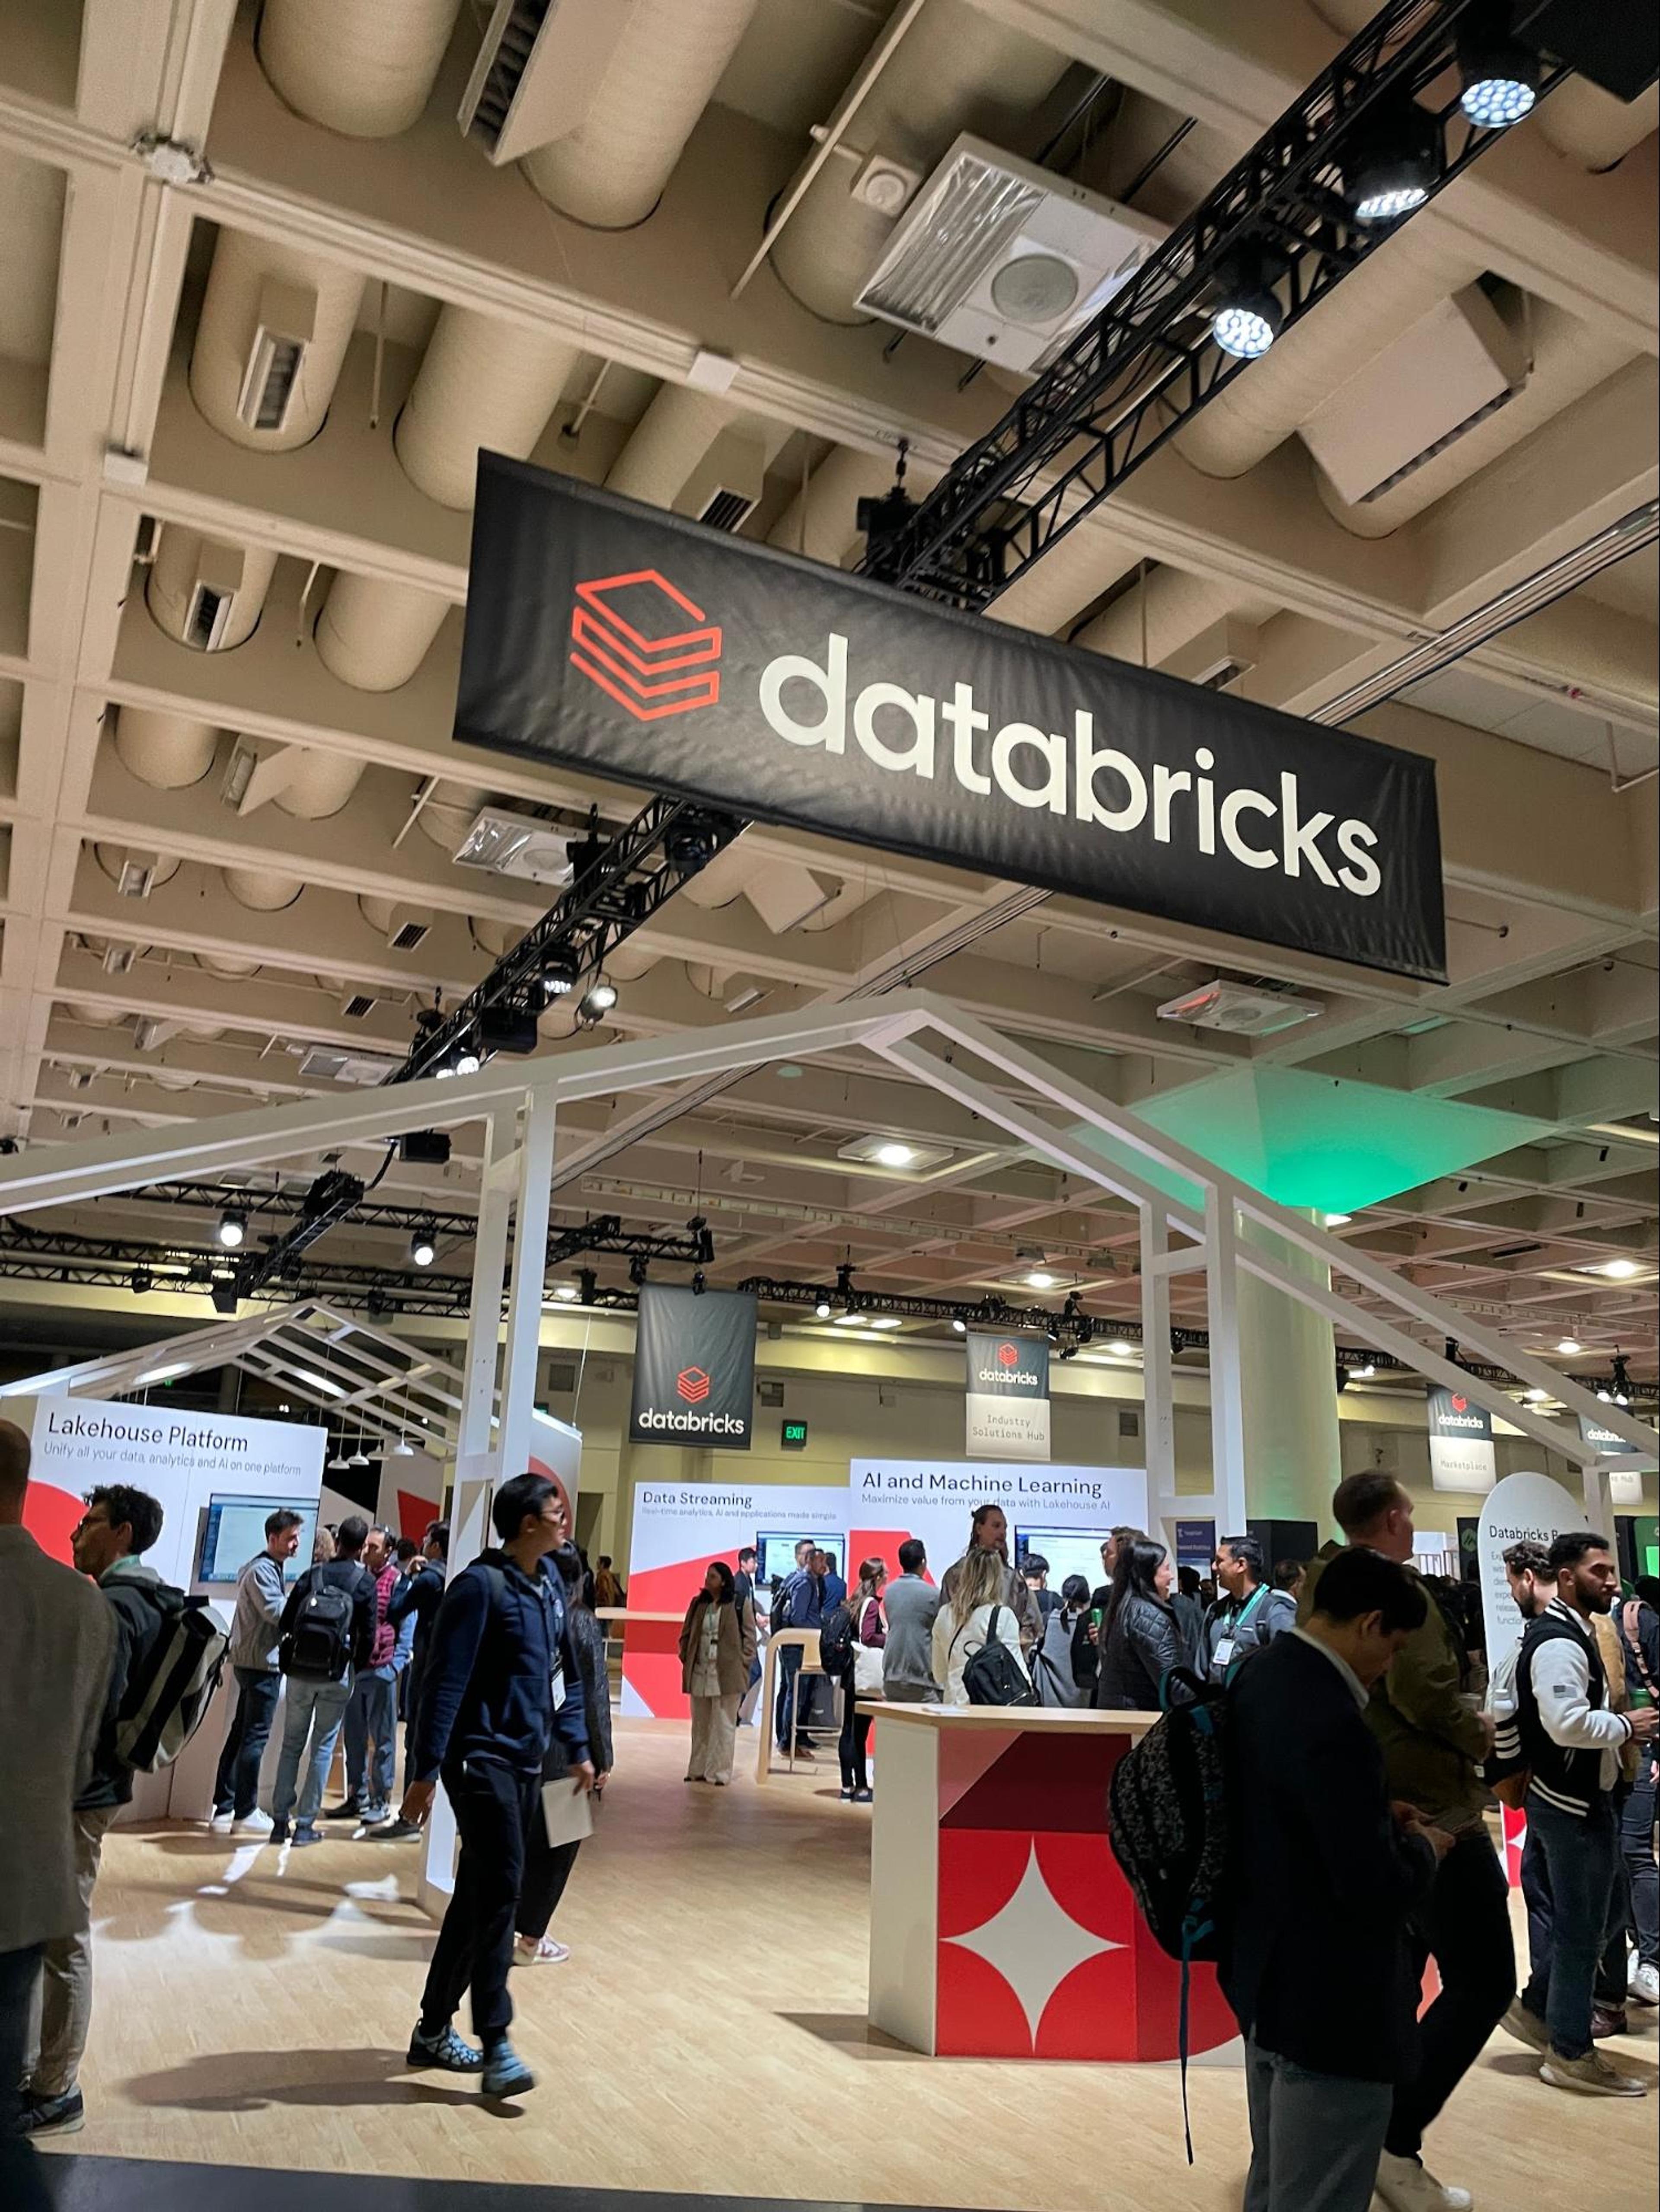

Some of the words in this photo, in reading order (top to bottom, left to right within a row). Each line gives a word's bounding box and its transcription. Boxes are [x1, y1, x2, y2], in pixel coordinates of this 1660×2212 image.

[759, 633, 1382, 897] databricks
[979, 1368, 1038, 1386] databricks
[638, 1408, 744, 1435] databricks
[987, 1414, 1031, 1428] Industry
[1439, 1413, 1484, 1429] databricks
[48, 1412, 163, 1443] Lakehouse
[169, 1426, 248, 1452] Platform
[785, 1426, 805, 1439] EXIT
[972, 1426, 1022, 1439] Solutions
[1028, 1431, 1044, 1441] Hub
[44, 1441, 73, 1459] Unify
[77, 1446, 89, 1458] all
[93, 1449, 117, 1462] your
[149, 1453, 195, 1468] analytics
[198, 1456, 216, 1469] and
[218, 1457, 228, 1469] AI
[230, 1461, 242, 1470] on
[245, 1462, 262, 1472] one
[263, 1462, 301, 1476] platform
[1440, 1460, 1488, 1470] Marketplace
[863, 1472, 881, 1488] AI
[887, 1473, 923, 1489] and
[930, 1474, 1012, 1491] Machine
[1019, 1477, 1101, 1499] Learning
[644, 1491, 676, 1504] Data
[680, 1492, 752, 1509] Streaming
[862, 1494, 908, 1505] Maximize
[912, 1495, 938, 1506] value
[941, 1496, 964, 1506] from
[1018, 1499, 1040, 1508] with
[1043, 1499, 1097, 1510] Lakehouse
[1101, 1501, 1110, 1510] AI
[725, 1508, 738, 1516] and
[741, 1510, 786, 1519] applications
[812, 1511, 836, 1521] simple
[1490, 1526, 1549, 1541] Databricks
